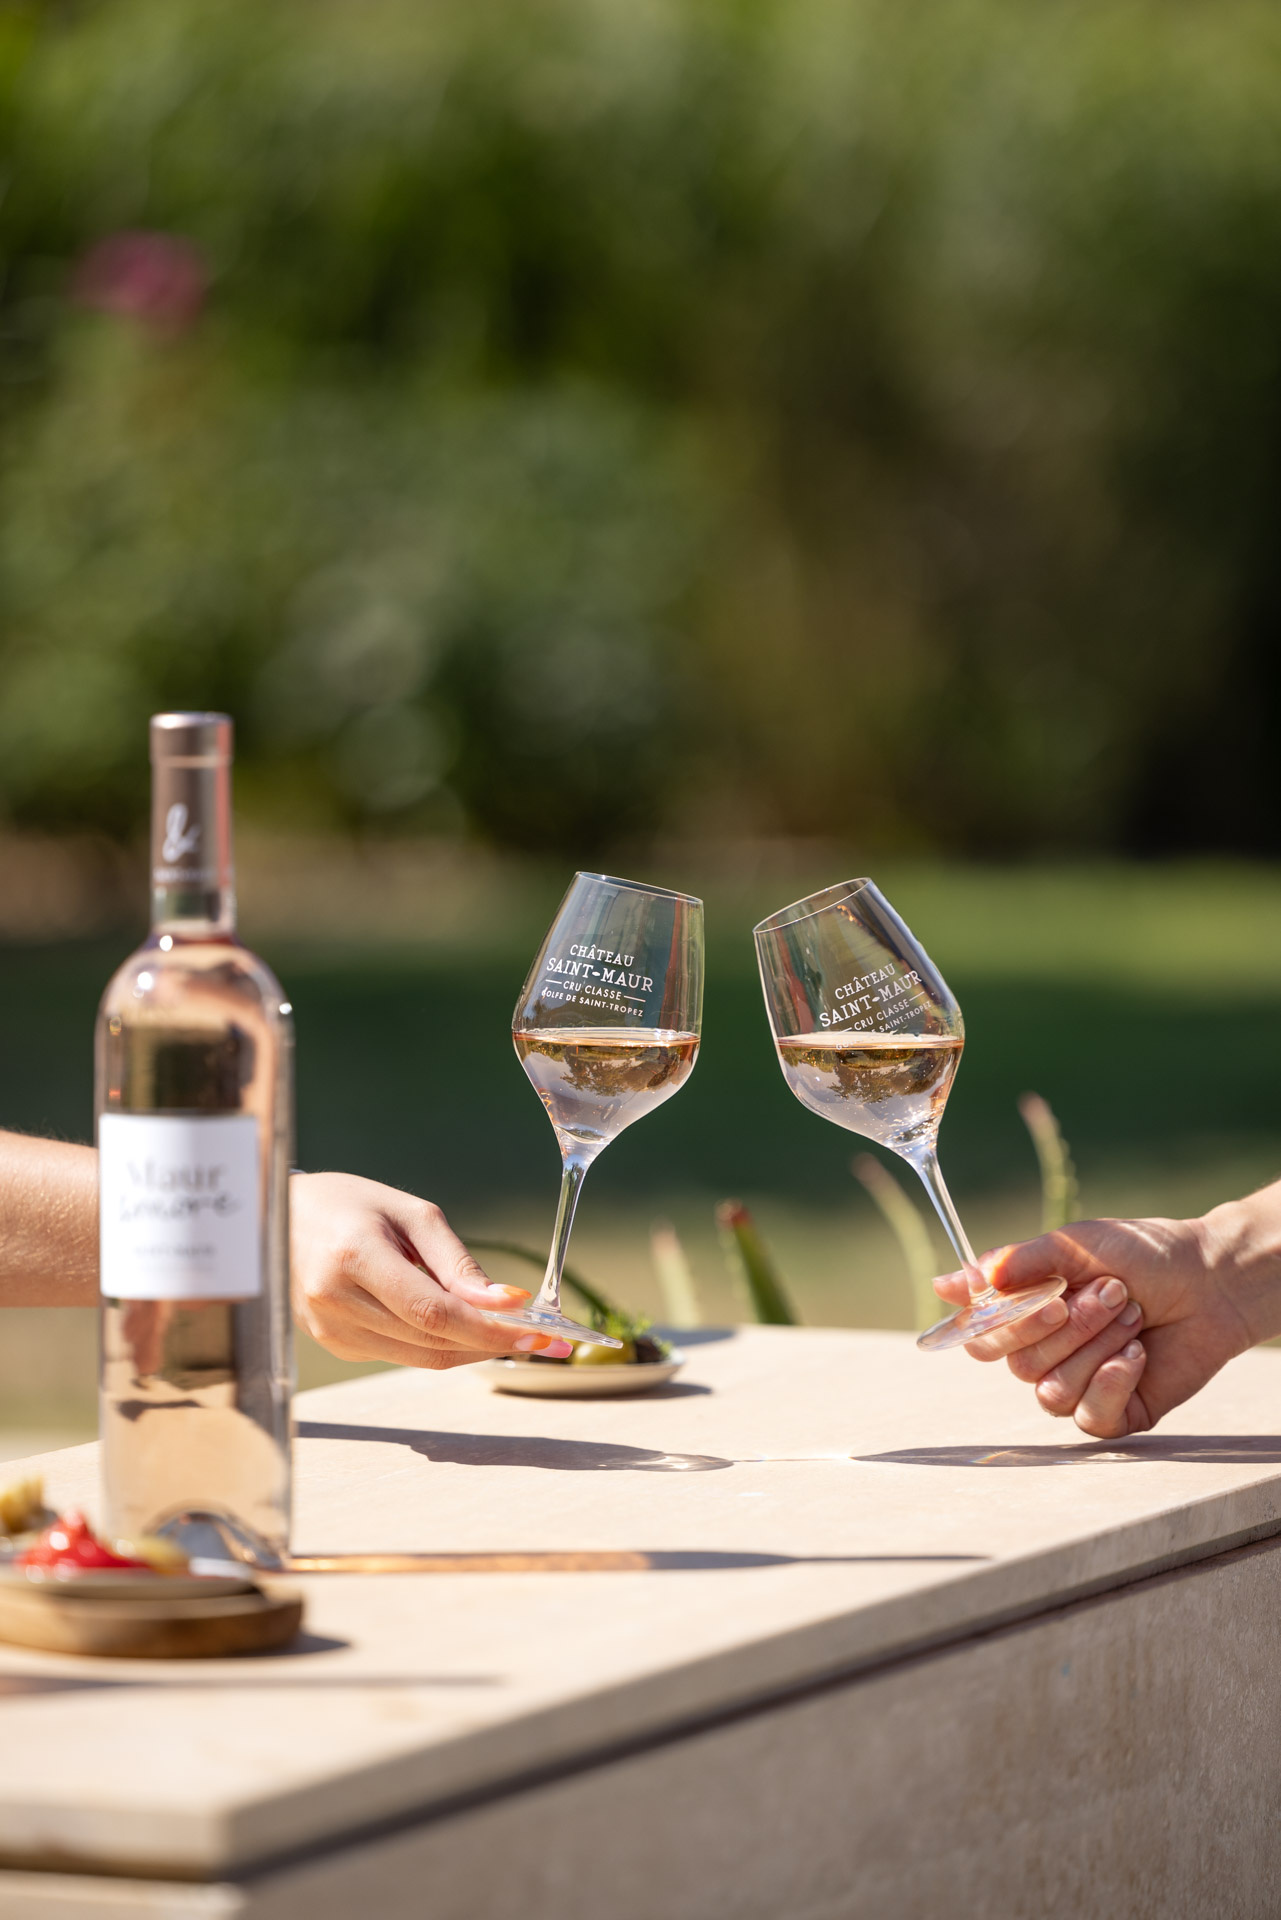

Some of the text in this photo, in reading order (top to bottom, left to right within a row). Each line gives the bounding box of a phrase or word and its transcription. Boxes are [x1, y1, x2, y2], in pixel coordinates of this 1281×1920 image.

[570, 944, 634, 967] CHÂTEAU
[546, 957, 653, 992] SAINT-MAUR
[563, 980, 622, 1001] CRU CLASSE
[834, 962, 896, 1000] CHÂTEAU
[541, 987, 644, 1017] GOLFE DE SAINT-TROPEZ
[819, 970, 922, 1027] SAINT-MAUR
[854, 998, 910, 1031] CRU CLASSE
[879, 1001, 932, 1033] SAINT-TROPEZ
